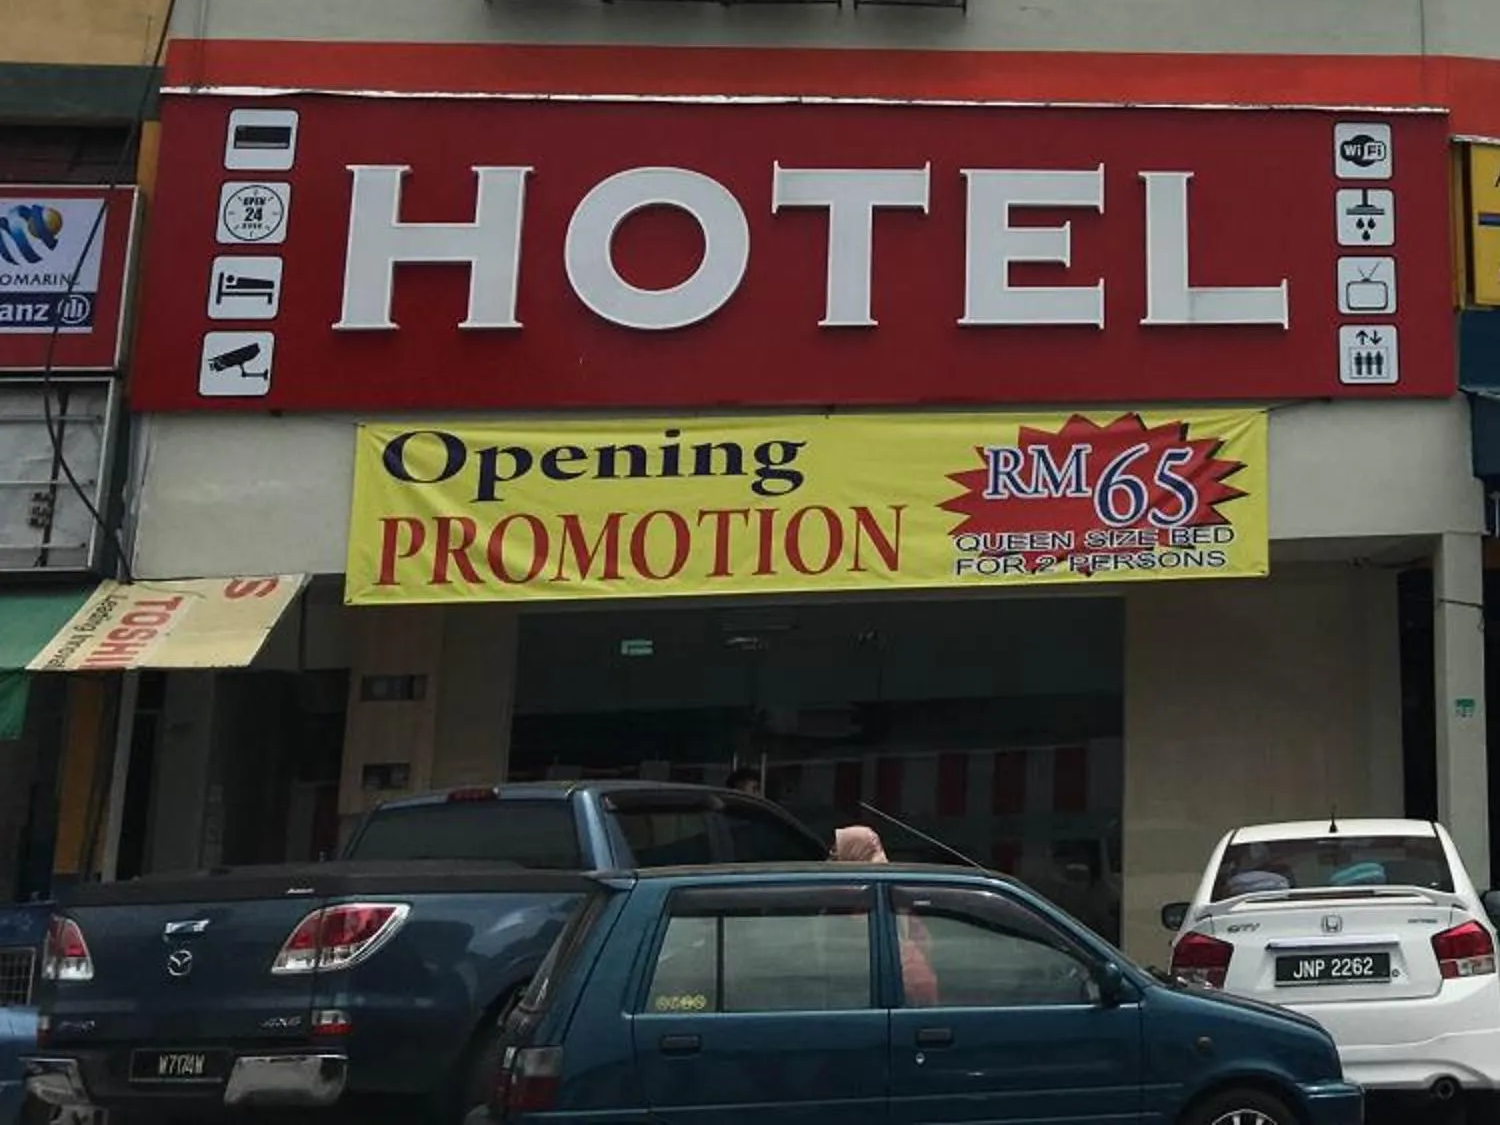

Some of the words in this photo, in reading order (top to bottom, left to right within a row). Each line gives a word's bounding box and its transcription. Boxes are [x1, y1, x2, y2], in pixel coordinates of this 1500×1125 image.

[243, 206, 263, 222] 24
[330, 159, 1289, 332] HOTEL
[381, 427, 808, 504] Opening
[982, 442, 1198, 527] RM65
[372, 502, 908, 587] PROMOTION
[954, 531, 1076, 553] QUEEN
[1083, 528, 1159, 550] SIZE
[1169, 526, 1235, 547] BED
[955, 555, 1026, 575] FOR
[1038, 555, 1056, 572] 2
[1069, 550, 1226, 572] PERSONS
[1292, 960, 1326, 979] JNP
[1330, 957, 1374, 976] 2262
